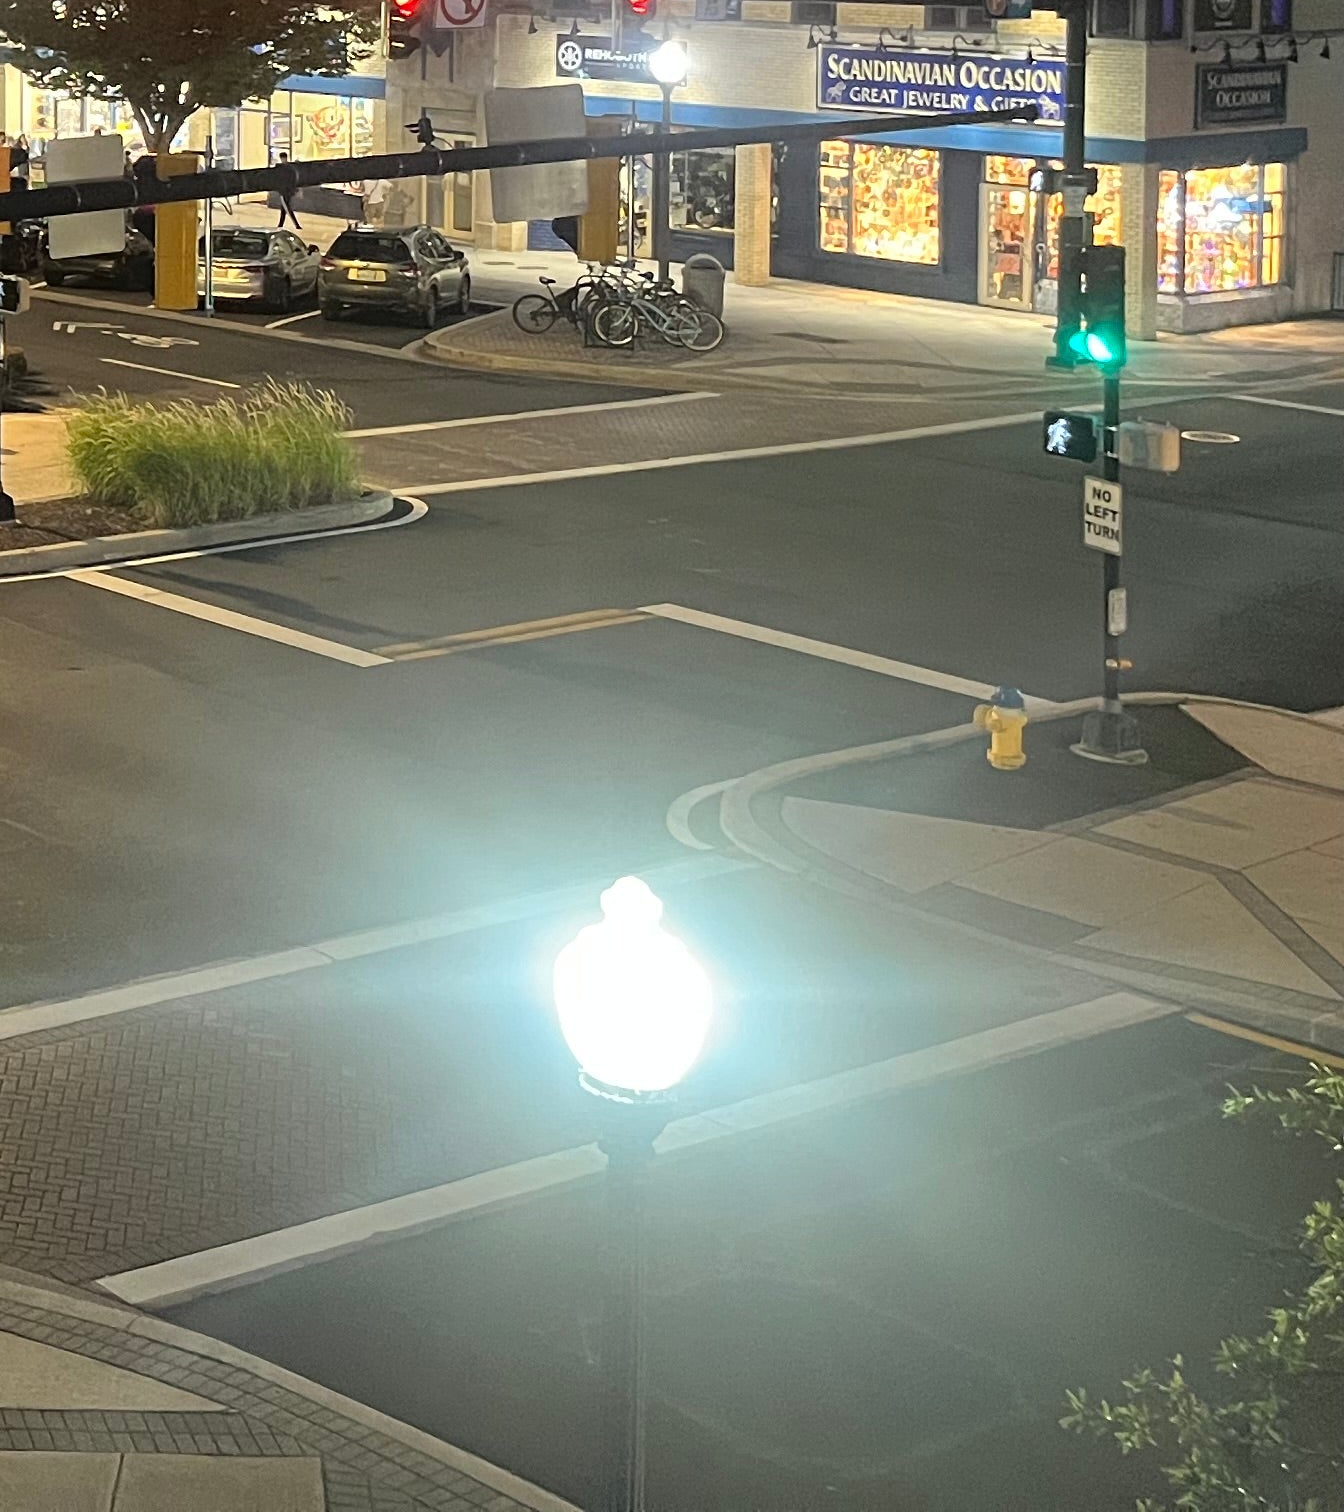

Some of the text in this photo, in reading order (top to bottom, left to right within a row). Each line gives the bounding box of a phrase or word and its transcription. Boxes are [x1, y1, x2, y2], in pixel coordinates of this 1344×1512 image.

[827, 53, 1062, 94] SCANDINAVIAN OCCASION
[849, 86, 899, 105] GREAT
[903, 91, 970, 111] JEWELRY
[973, 95, 990, 112] &
[1216, 90, 1272, 108] OCCASION
[1093, 486, 1112, 503] NO
[1085, 502, 1119, 523] LEFT
[1085, 520, 1120, 542] TURN
